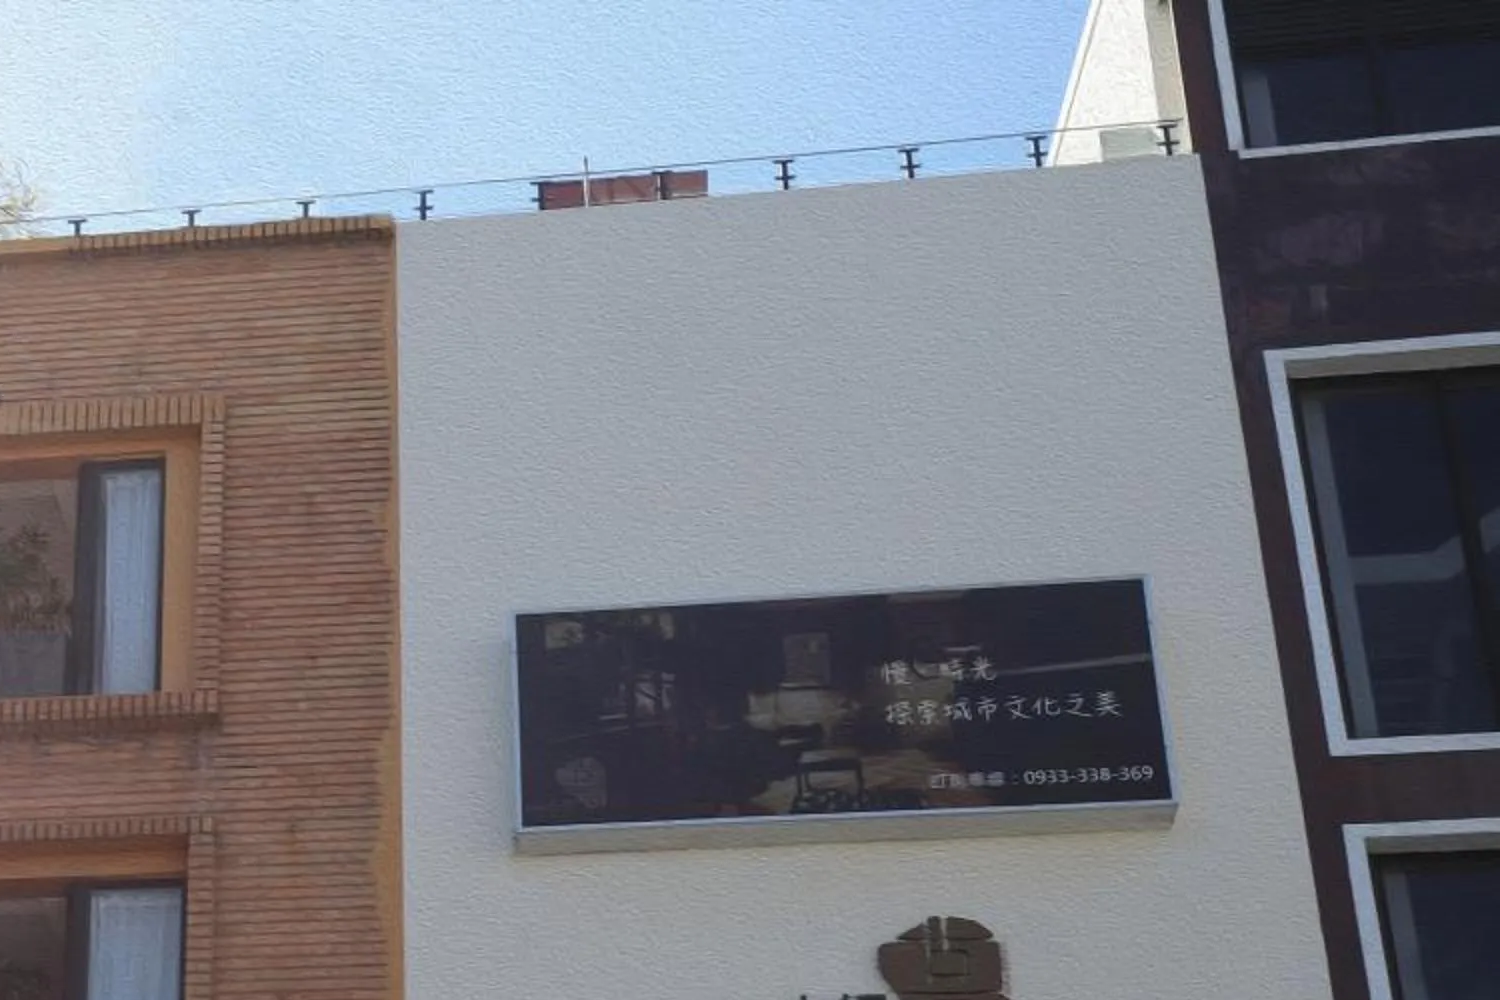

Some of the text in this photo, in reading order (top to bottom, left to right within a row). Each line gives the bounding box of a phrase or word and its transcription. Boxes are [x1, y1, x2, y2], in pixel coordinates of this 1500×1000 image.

[885, 691, 1124, 725] 探索城市文化之美
[1023, 765, 1154, 786] 0933-338-369
